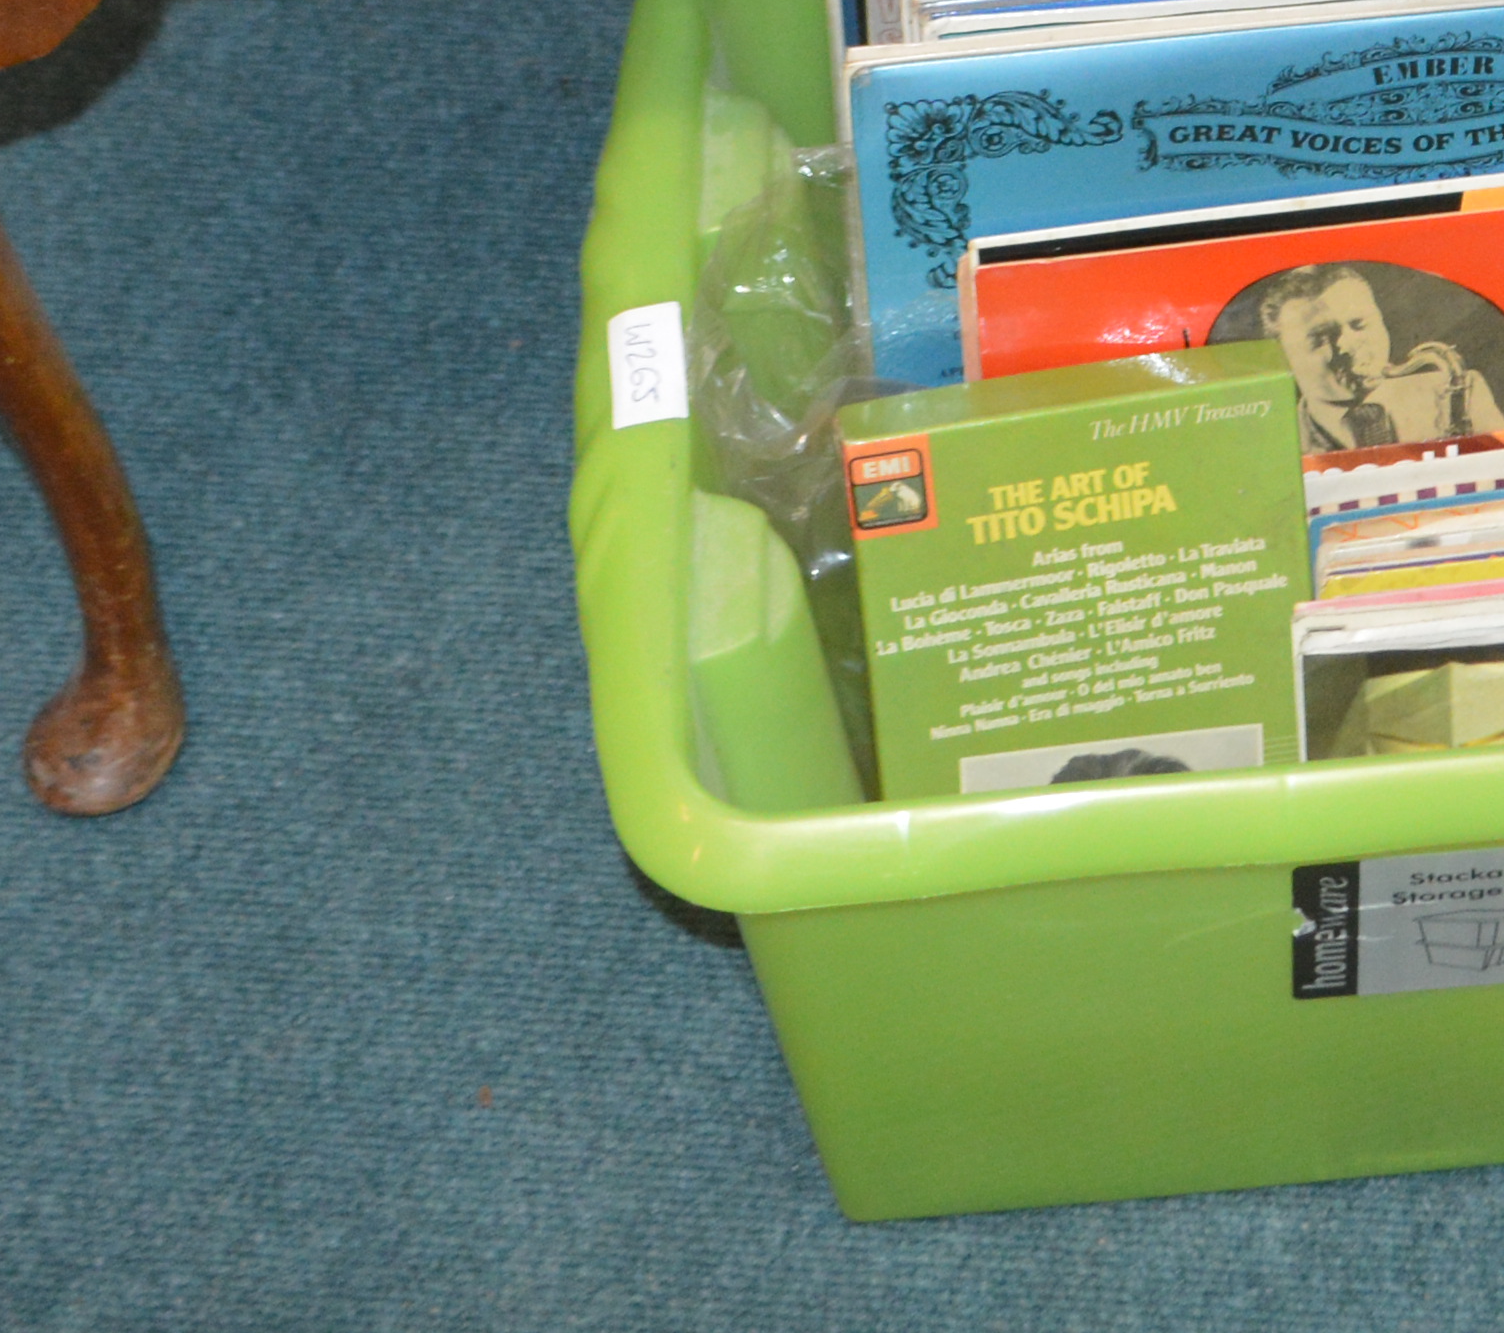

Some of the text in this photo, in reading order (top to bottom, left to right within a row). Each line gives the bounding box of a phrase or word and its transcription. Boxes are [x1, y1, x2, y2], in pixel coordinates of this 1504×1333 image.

[1372, 55, 1497, 86] EMBER
[1168, 124, 1282, 146] GREAT
[1291, 129, 1403, 156] VOICES
[1412, 130, 1458, 153] OF
[624, 322, 662, 403] W265
[1088, 397, 1274, 441] The HMV Treasury
[861, 455, 912, 479] EMI
[987, 461, 1151, 511] THE ART OF
[965, 484, 1178, 545] TITO SCHIPA
[890, 536, 1267, 612] Lucia di Lammermoor Rigoletto La Traviata
[1031, 540, 1124, 567] Arias from
[875, 639, 899, 657] La
[983, 616, 1033, 637] Tosca
[1043, 608, 1086, 628] Zaza
[1096, 590, 1163, 617] Falstaff
[1174, 586, 1210, 605] Don
[1212, 572, 1289, 598] Pasquale
[903, 559, 1258, 631] La Gioconda Cavalleria Rusticana Manon
[947, 605, 1224, 665] La Sonnambula L'Elisir d'amore
[958, 659, 1022, 684] Andrea
[1105, 633, 1175, 657] L'Amico
[1176, 625, 1217, 645] Fritz
[959, 698, 1005, 719] Plaisir
[1077, 682, 1090, 697] O
[1092, 677, 1116, 695] del
[1116, 673, 1146, 691] mio
[1147, 666, 1194, 685] amato
[1194, 662, 1223, 677] ben
[1021, 655, 1160, 689] and songs including
[1027, 706, 1053, 723] Era
[1054, 701, 1071, 719] di
[1071, 693, 1126, 715] maggio
[1132, 687, 1174, 704] Torna
[1391, 881, 1504, 906] Storage
[1301, 875, 1350, 992] homeware
